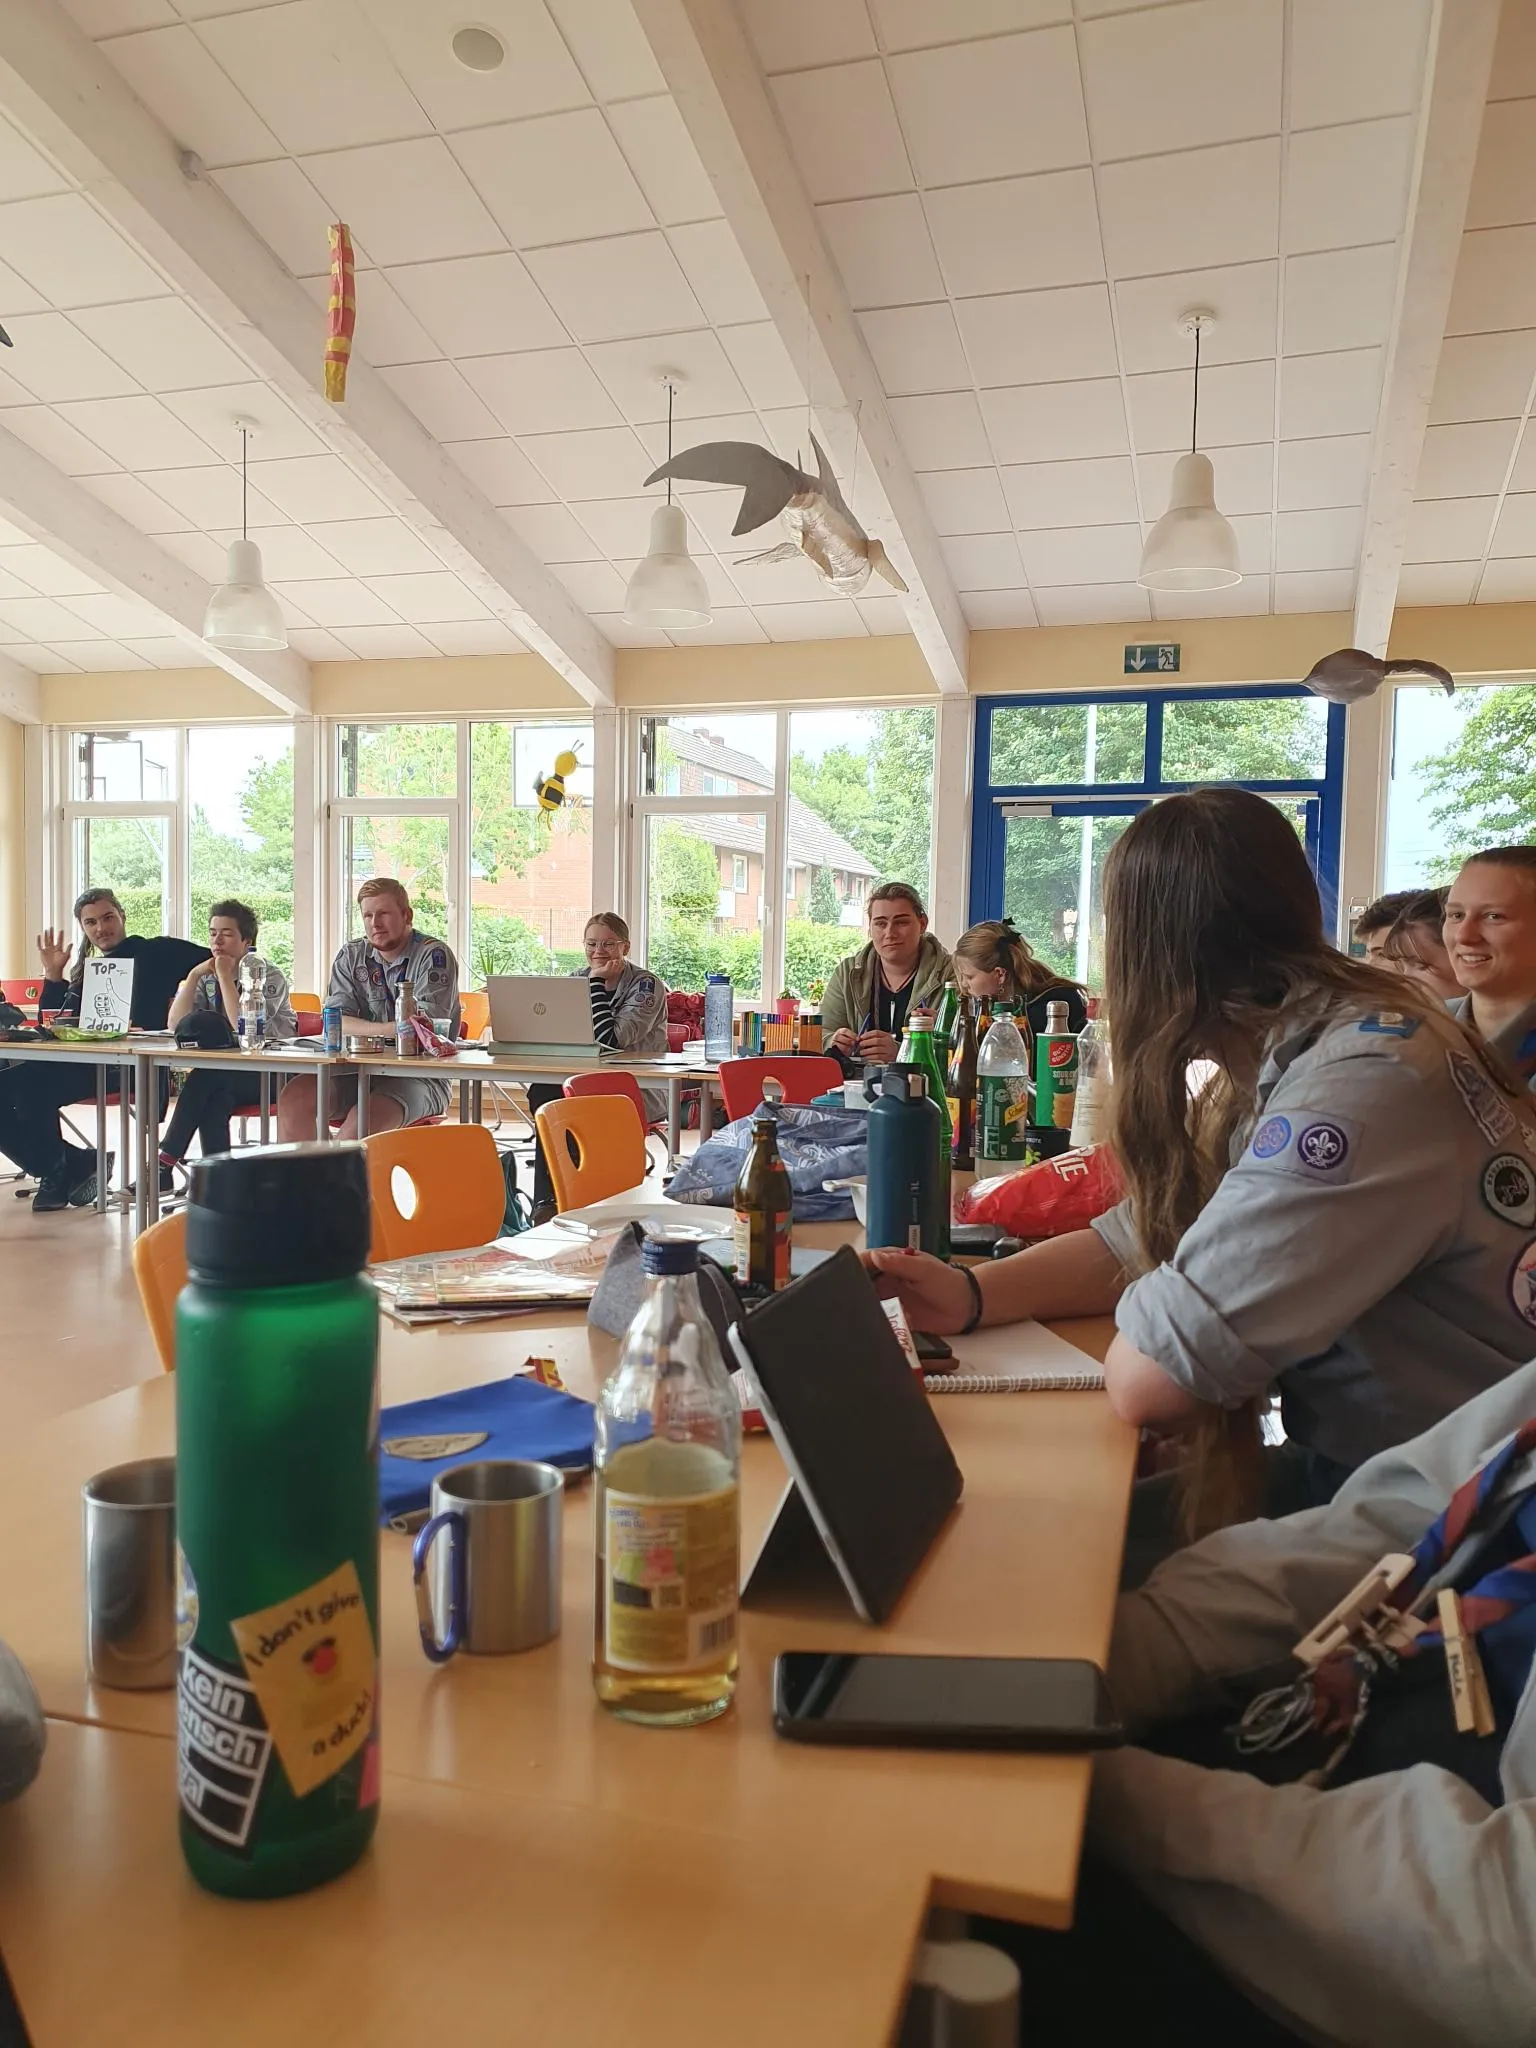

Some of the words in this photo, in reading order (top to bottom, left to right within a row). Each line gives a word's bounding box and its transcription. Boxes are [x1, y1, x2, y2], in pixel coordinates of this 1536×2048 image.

[91, 963, 117, 975] TOP
[258, 1607, 315, 1658] don't
[319, 1589, 361, 1624] give
[182, 1665, 246, 1720] kein
[180, 1699, 257, 1766] ensch
